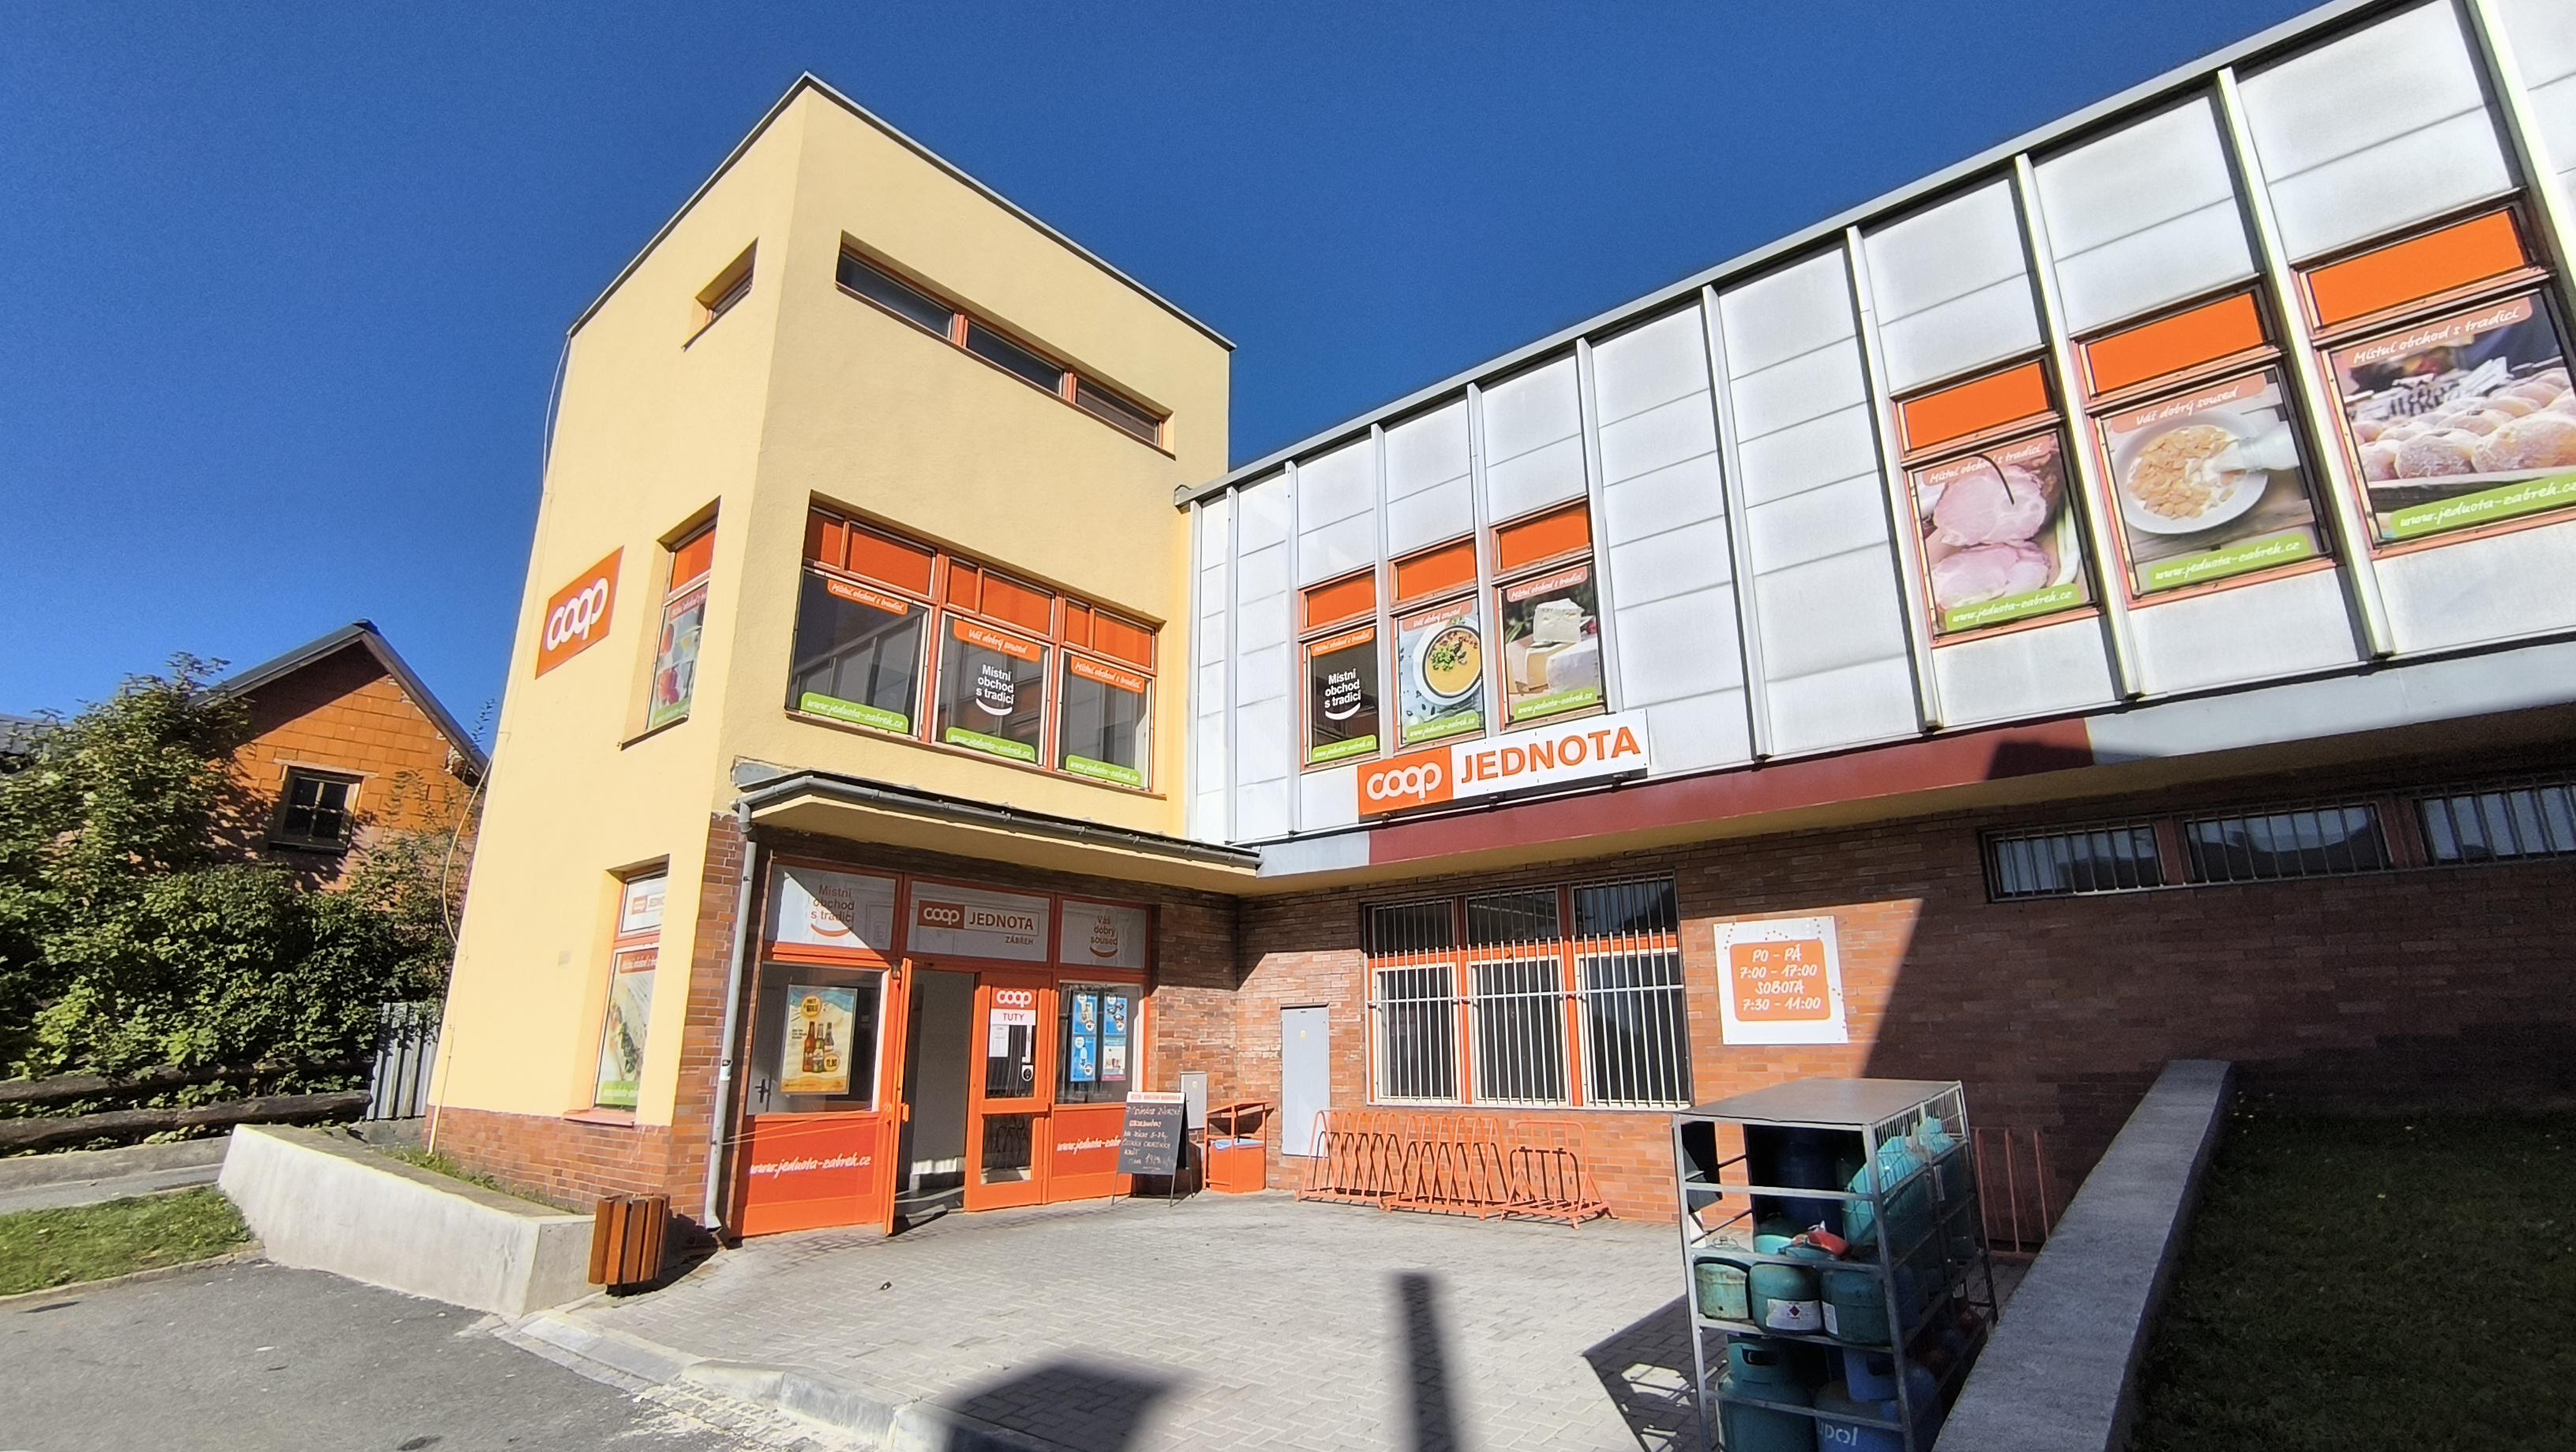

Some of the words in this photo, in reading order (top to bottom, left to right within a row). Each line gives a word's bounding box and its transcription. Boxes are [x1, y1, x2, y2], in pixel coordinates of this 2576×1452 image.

[2353, 341, 2398, 365] Místní
[2399, 324, 2451, 350] obchod
[2452, 325, 2461, 335] s
[2466, 306, 2520, 332] tradicí
[2136, 410, 2157, 425] Váš
[2159, 401, 2194, 416] dobrý
[2197, 385, 2239, 408] soused
[2005, 443, 2042, 462] tradicí
[2400, 481, 2576, 528] www.jednota-zabreh.cz
[2155, 541, 2301, 579] www.jednota-zabreh.cz
[546, 577, 609, 651] coop
[1953, 590, 2072, 623] www.jednota-zabreh.cz
[982, 664, 1012, 681] Místní
[1328, 668, 1357, 685] Místní
[977, 676, 1014, 693] obchod
[1325, 679, 1360, 697] obchod
[975, 687, 983, 696] s
[984, 688, 1015, 705] tradicí
[1324, 699, 1331, 709] s
[1332, 689, 1361, 706] tradicí
[1366, 762, 1443, 801] coop
[1461, 726, 1642, 784] JEDNOTA
[818, 884, 852, 897] Místní
[814, 897, 855, 910] obchod
[811, 911, 817, 919] s
[821, 910, 855, 922] tradicí
[923, 908, 960, 925] coop
[969, 911, 1034, 930] JEDNOTA
[1005, 934, 1034, 945] ZÁBŘEH
[1091, 934, 1118, 945] soused
[1094, 924, 1115, 937] dobrý
[1752, 949, 1769, 962] PO
[1784, 943, 1802, 961] PÁ
[1739, 966, 1767, 979] 7:00
[1781, 964, 1818, 977] 17:00
[1754, 979, 1805, 994] SOBOTA
[996, 990, 1032, 1009] coop
[1743, 998, 1770, 1011] 7:30
[1784, 997, 1821, 1009] 11:00
[750, 1151, 871, 1179] www.jednota-zabreh.cz
